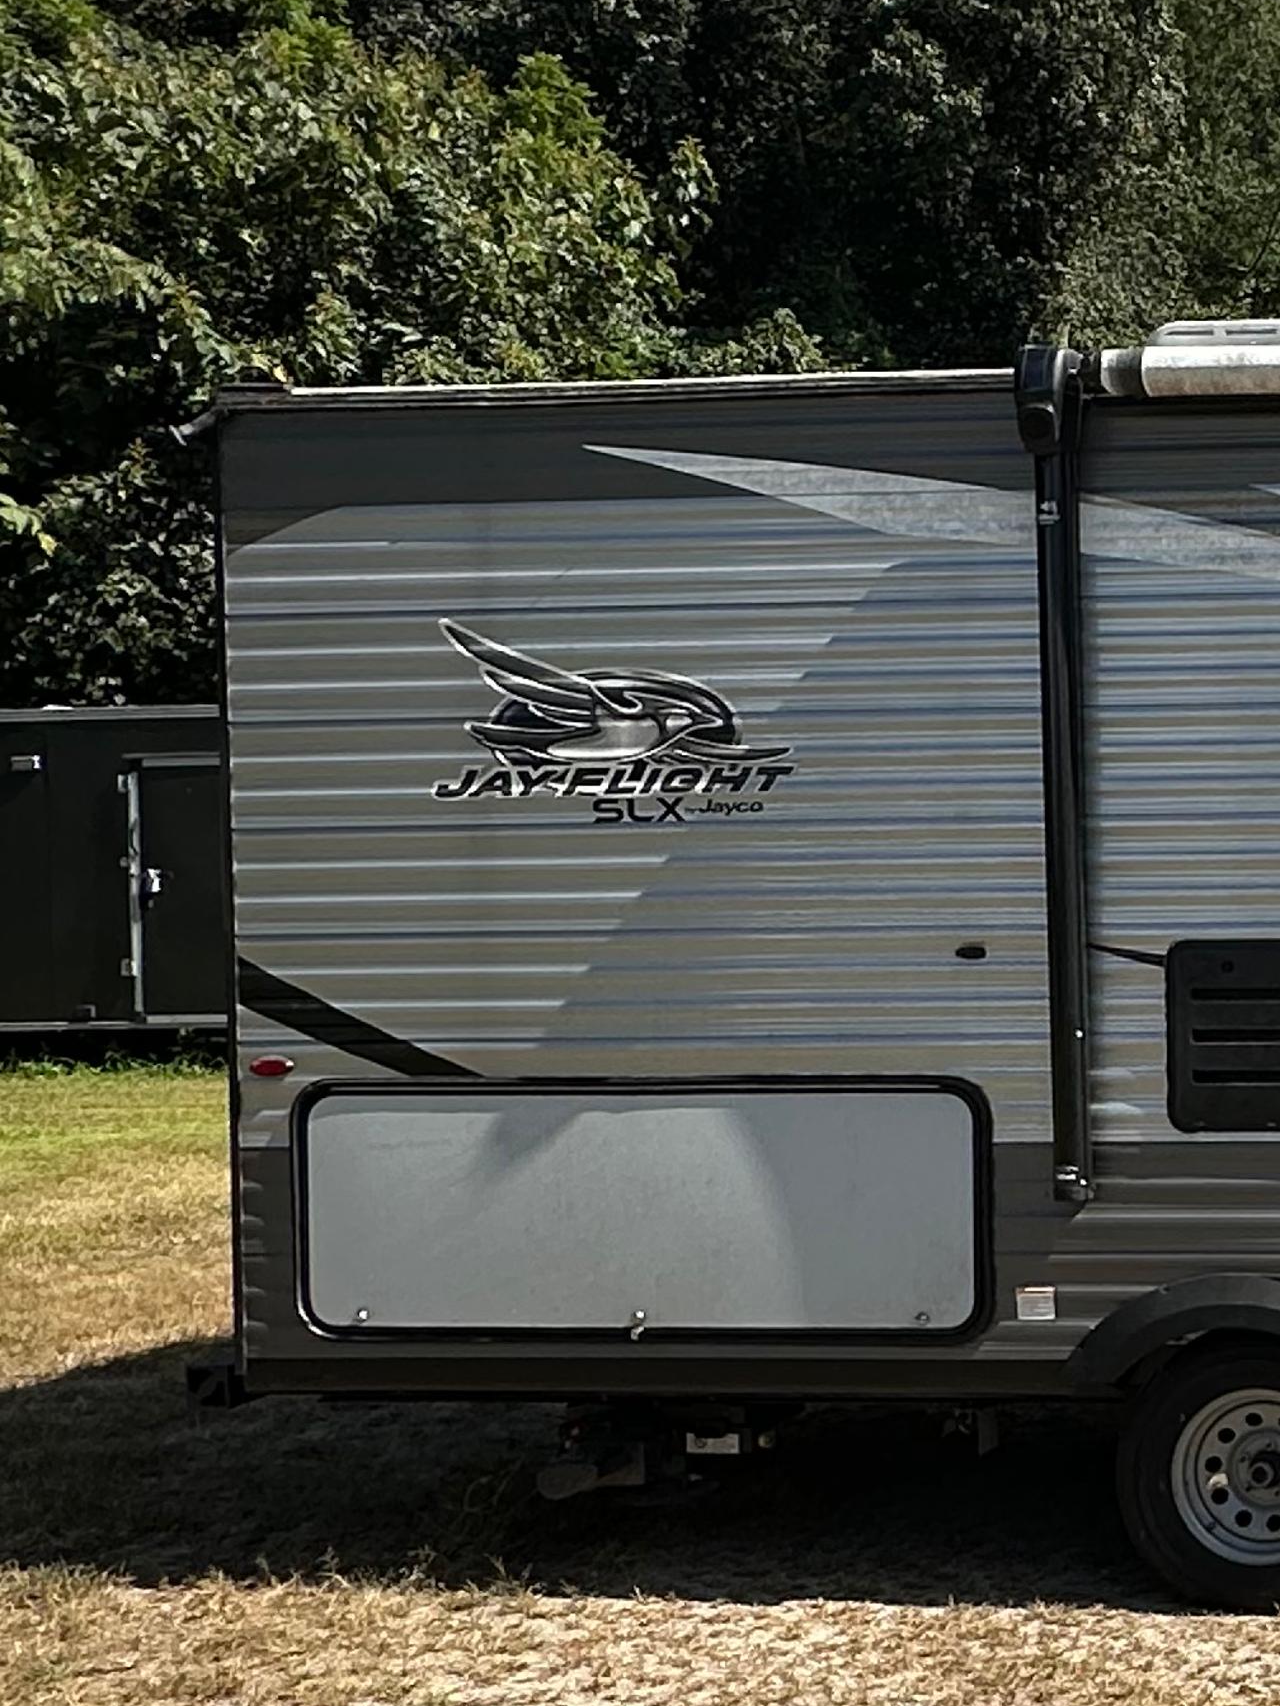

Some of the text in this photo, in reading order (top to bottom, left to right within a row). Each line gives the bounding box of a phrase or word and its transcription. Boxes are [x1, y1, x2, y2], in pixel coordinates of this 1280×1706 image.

[557, 764, 796, 797] FLIGHT
[592, 797, 687, 823] SLX
[699, 798, 764, 816] Jayco
